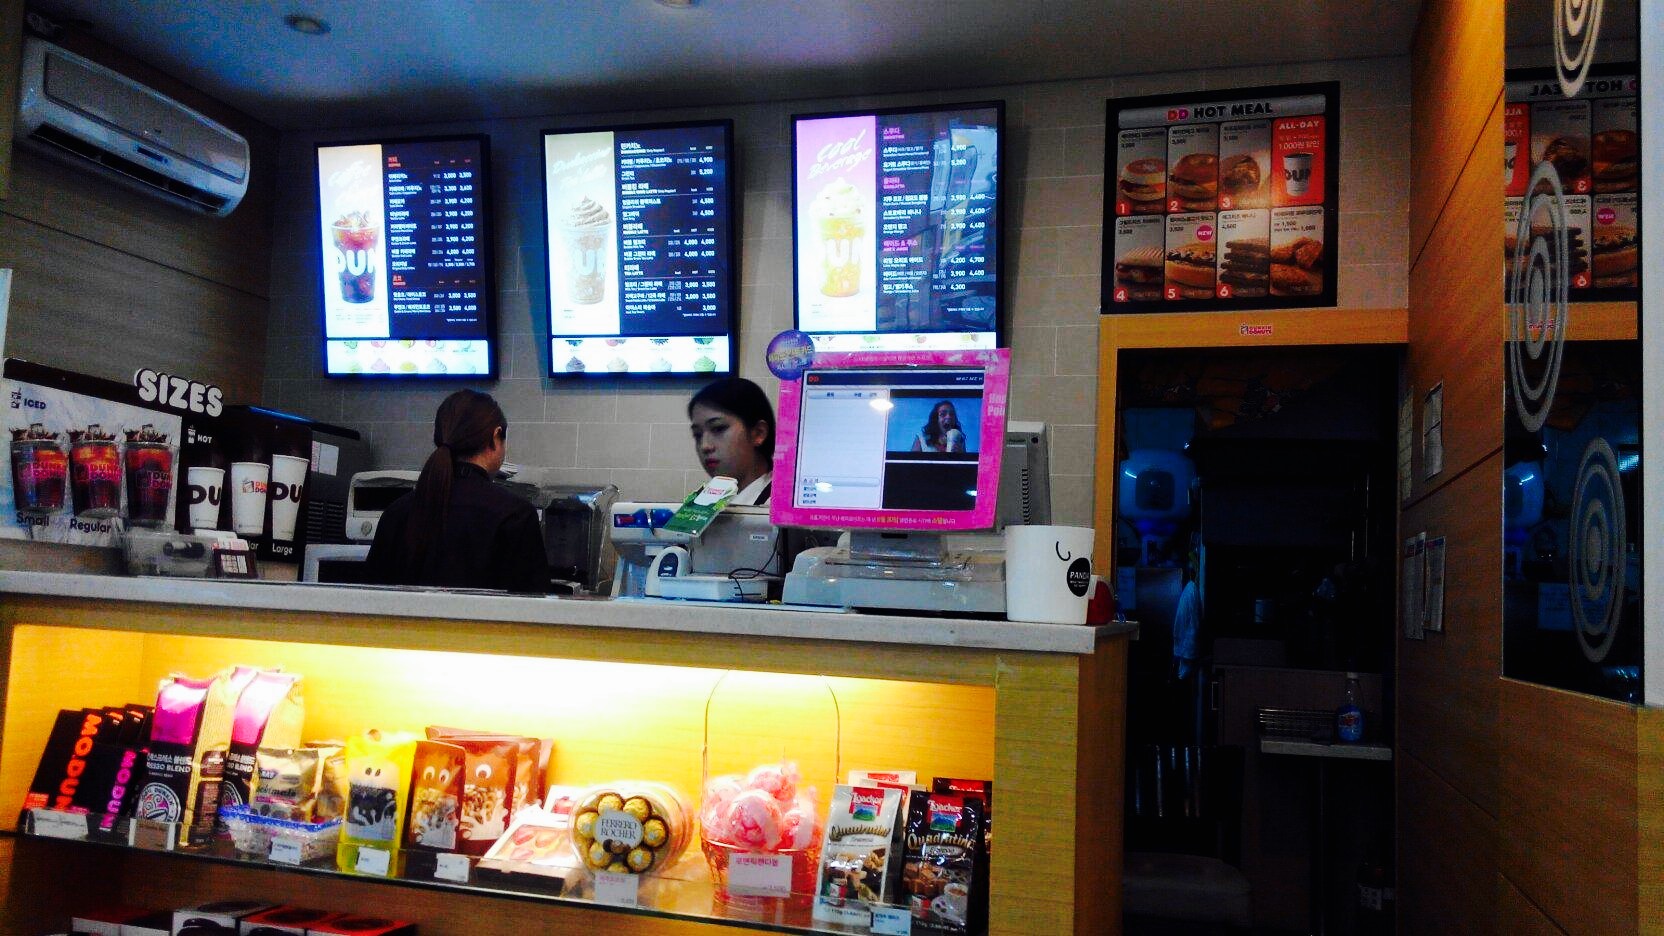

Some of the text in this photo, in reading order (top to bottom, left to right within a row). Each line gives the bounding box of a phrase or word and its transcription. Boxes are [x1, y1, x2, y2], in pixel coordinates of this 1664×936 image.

[1168, 103, 1272, 120] DD HOT MEAL
[1280, 120, 1320, 130] ALL-DAY
[1170, 200, 1179, 211] 2
[1222, 195, 1231, 207] 3
[1119, 203, 1126, 214] 1
[1116, 290, 1125, 301] 4
[1167, 288, 1176, 299] 5
[1219, 286, 1229, 297] 6
[135, 369, 224, 417] SIZES
[24, 398, 46, 410] ICED
[197, 433, 213, 446] HOT
[16, 511, 49, 526] Small
[70, 519, 112, 536] Regular
[272, 543, 293, 556] Large
[166, 763, 191, 773] BLEND
[851, 792, 884, 805] Loacker
[927, 799, 963, 813] Loacker
[600, 818, 638, 830] FERRERO
[601, 827, 636, 840] ROCHER
